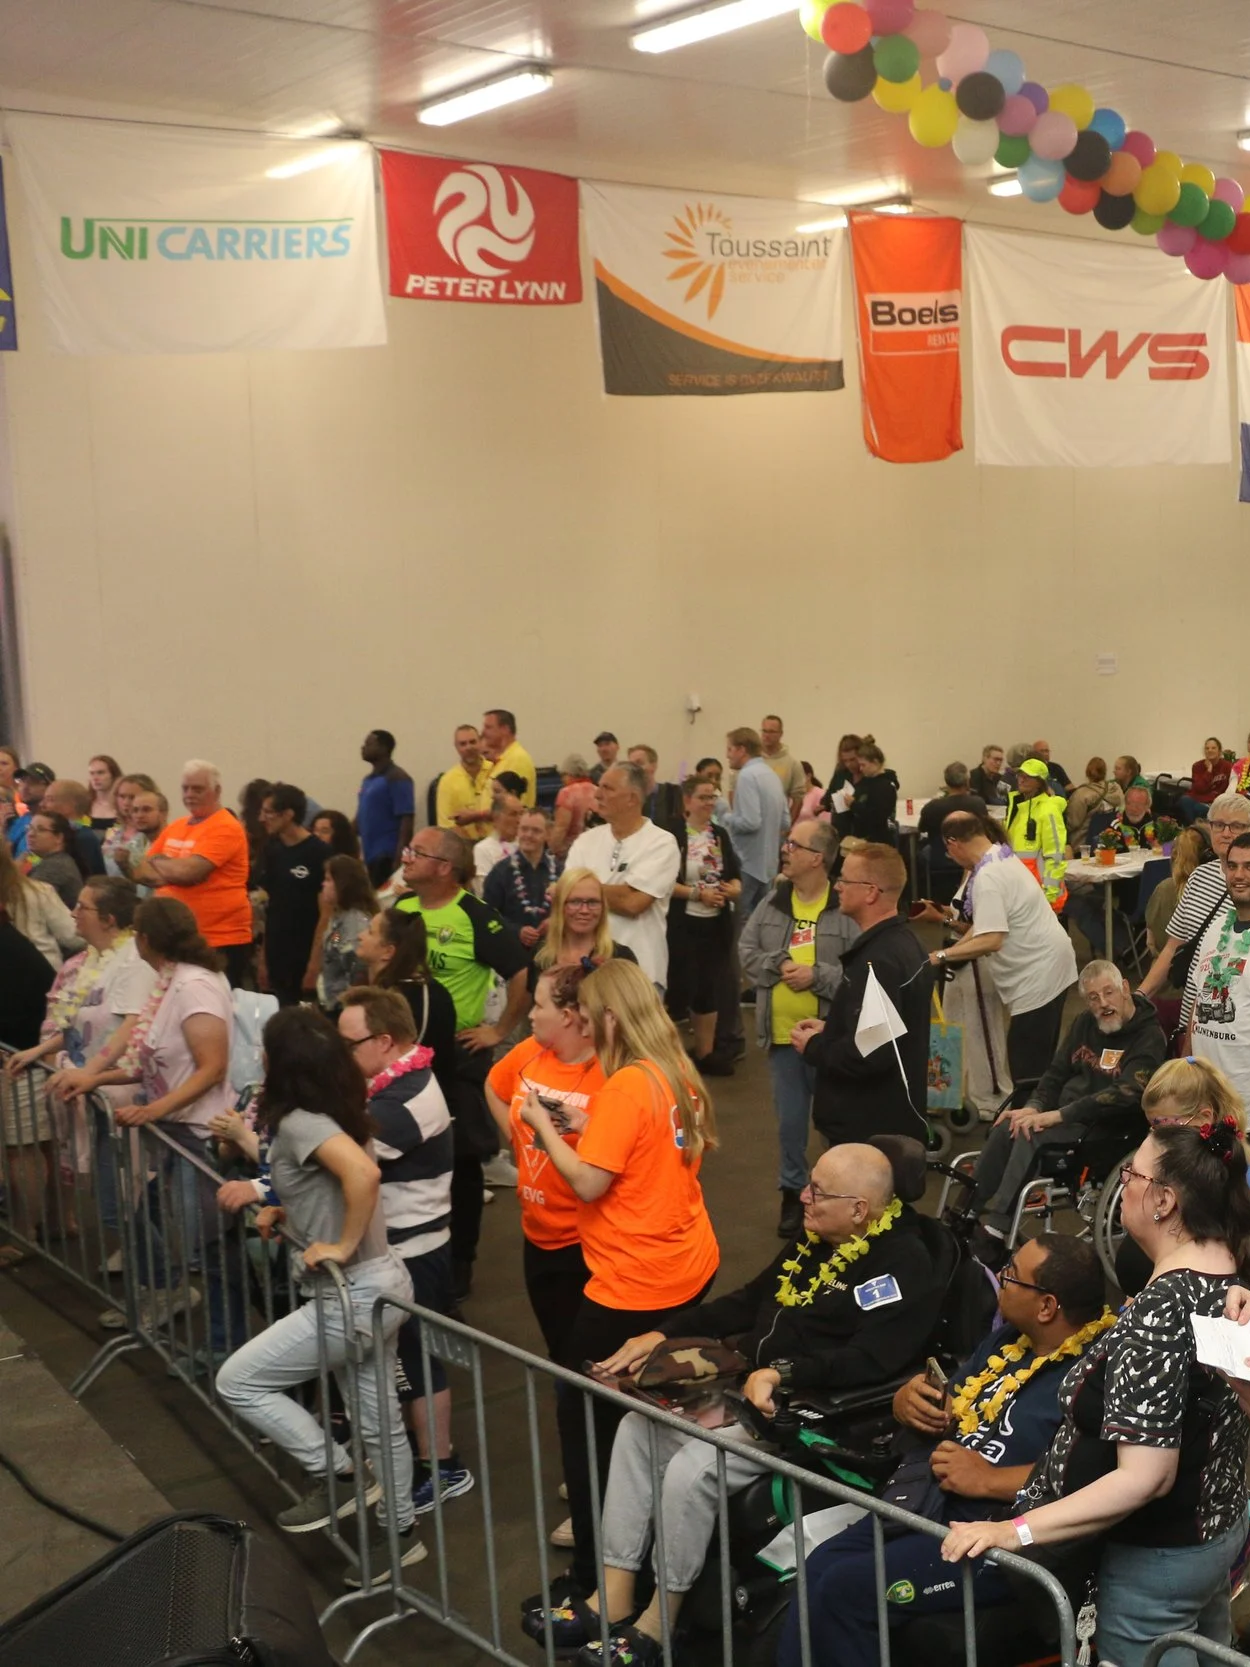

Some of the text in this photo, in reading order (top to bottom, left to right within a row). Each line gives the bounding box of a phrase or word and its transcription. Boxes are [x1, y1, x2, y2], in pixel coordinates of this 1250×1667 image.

[705, 232, 832, 258] Toussaint
[405, 274, 566, 300] PETER LYNN
[870, 299, 959, 326] Boels
[1001, 324, 1210, 381] CWS
[523, 1184, 545, 1205] EVG
[872, 1289, 879, 1298] 1
